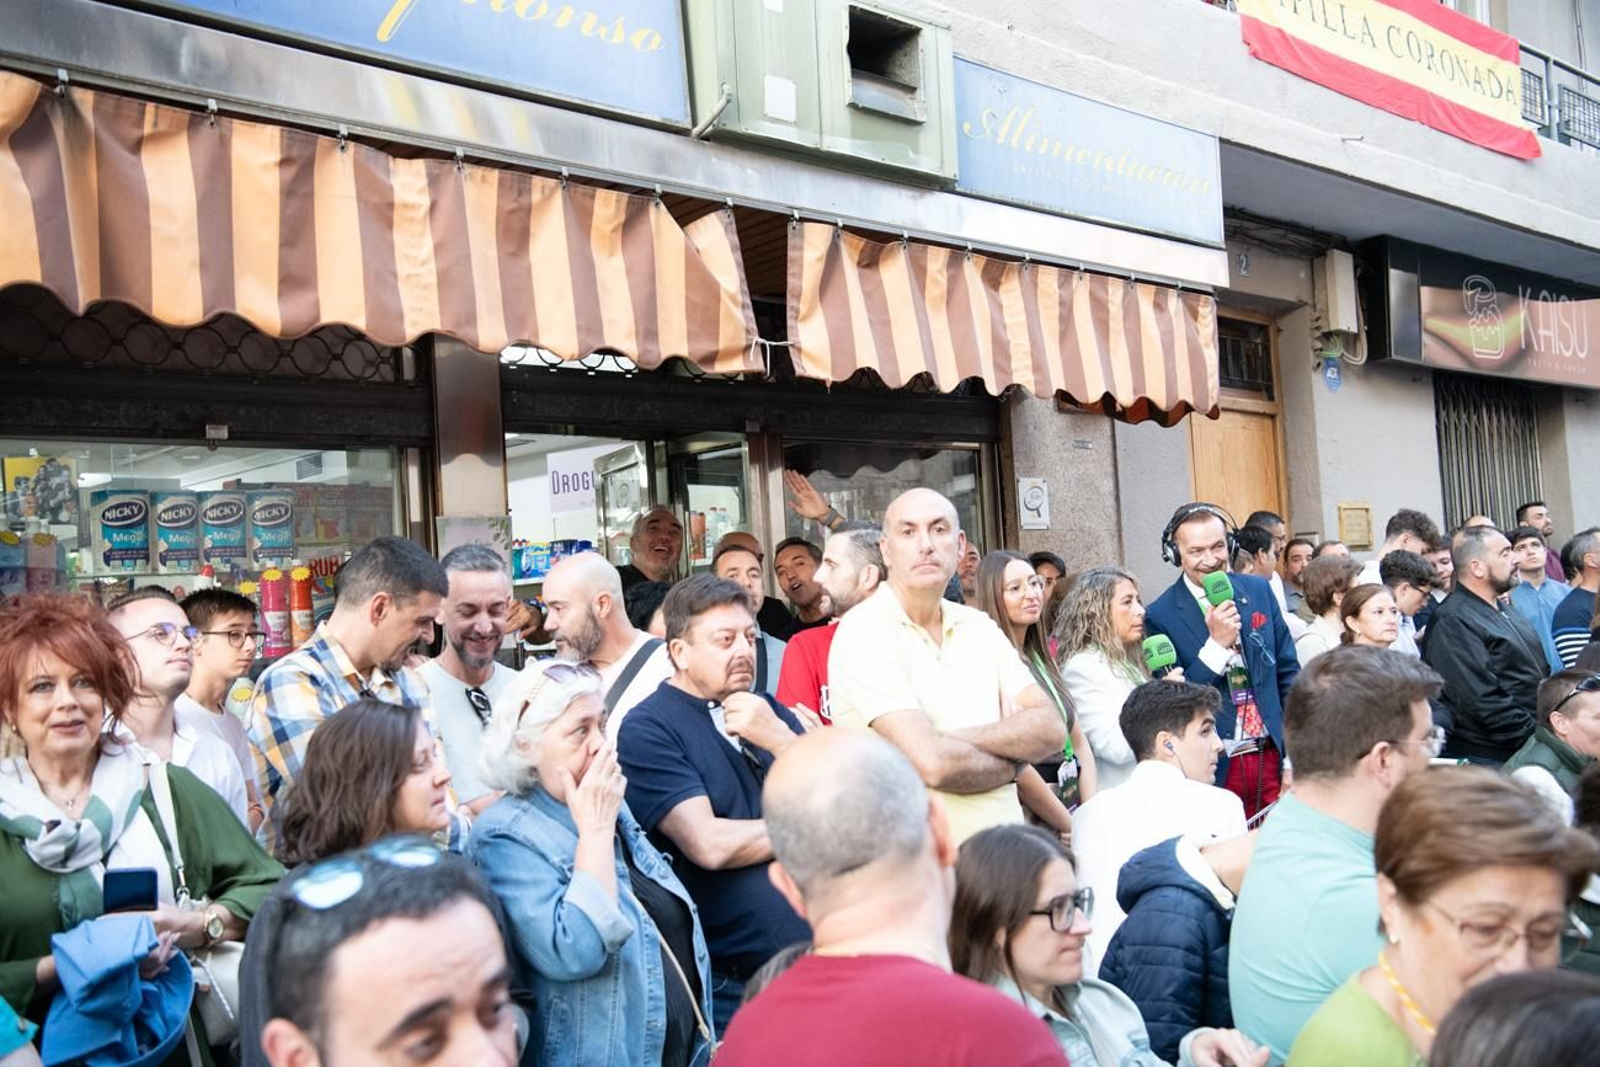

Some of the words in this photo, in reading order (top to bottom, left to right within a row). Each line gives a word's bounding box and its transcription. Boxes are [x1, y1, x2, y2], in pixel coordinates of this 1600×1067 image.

[1279, 0, 1377, 49] ILLA
[1387, 24, 1517, 106] CORONADA
[1518, 284, 1588, 359] KAISU
[105, 504, 140, 520] NICKY
[160, 506, 194, 521] NICKY
[206, 504, 238, 520] NICKY
[254, 506, 286, 521] NICKY
[169, 533, 195, 545] Meg
